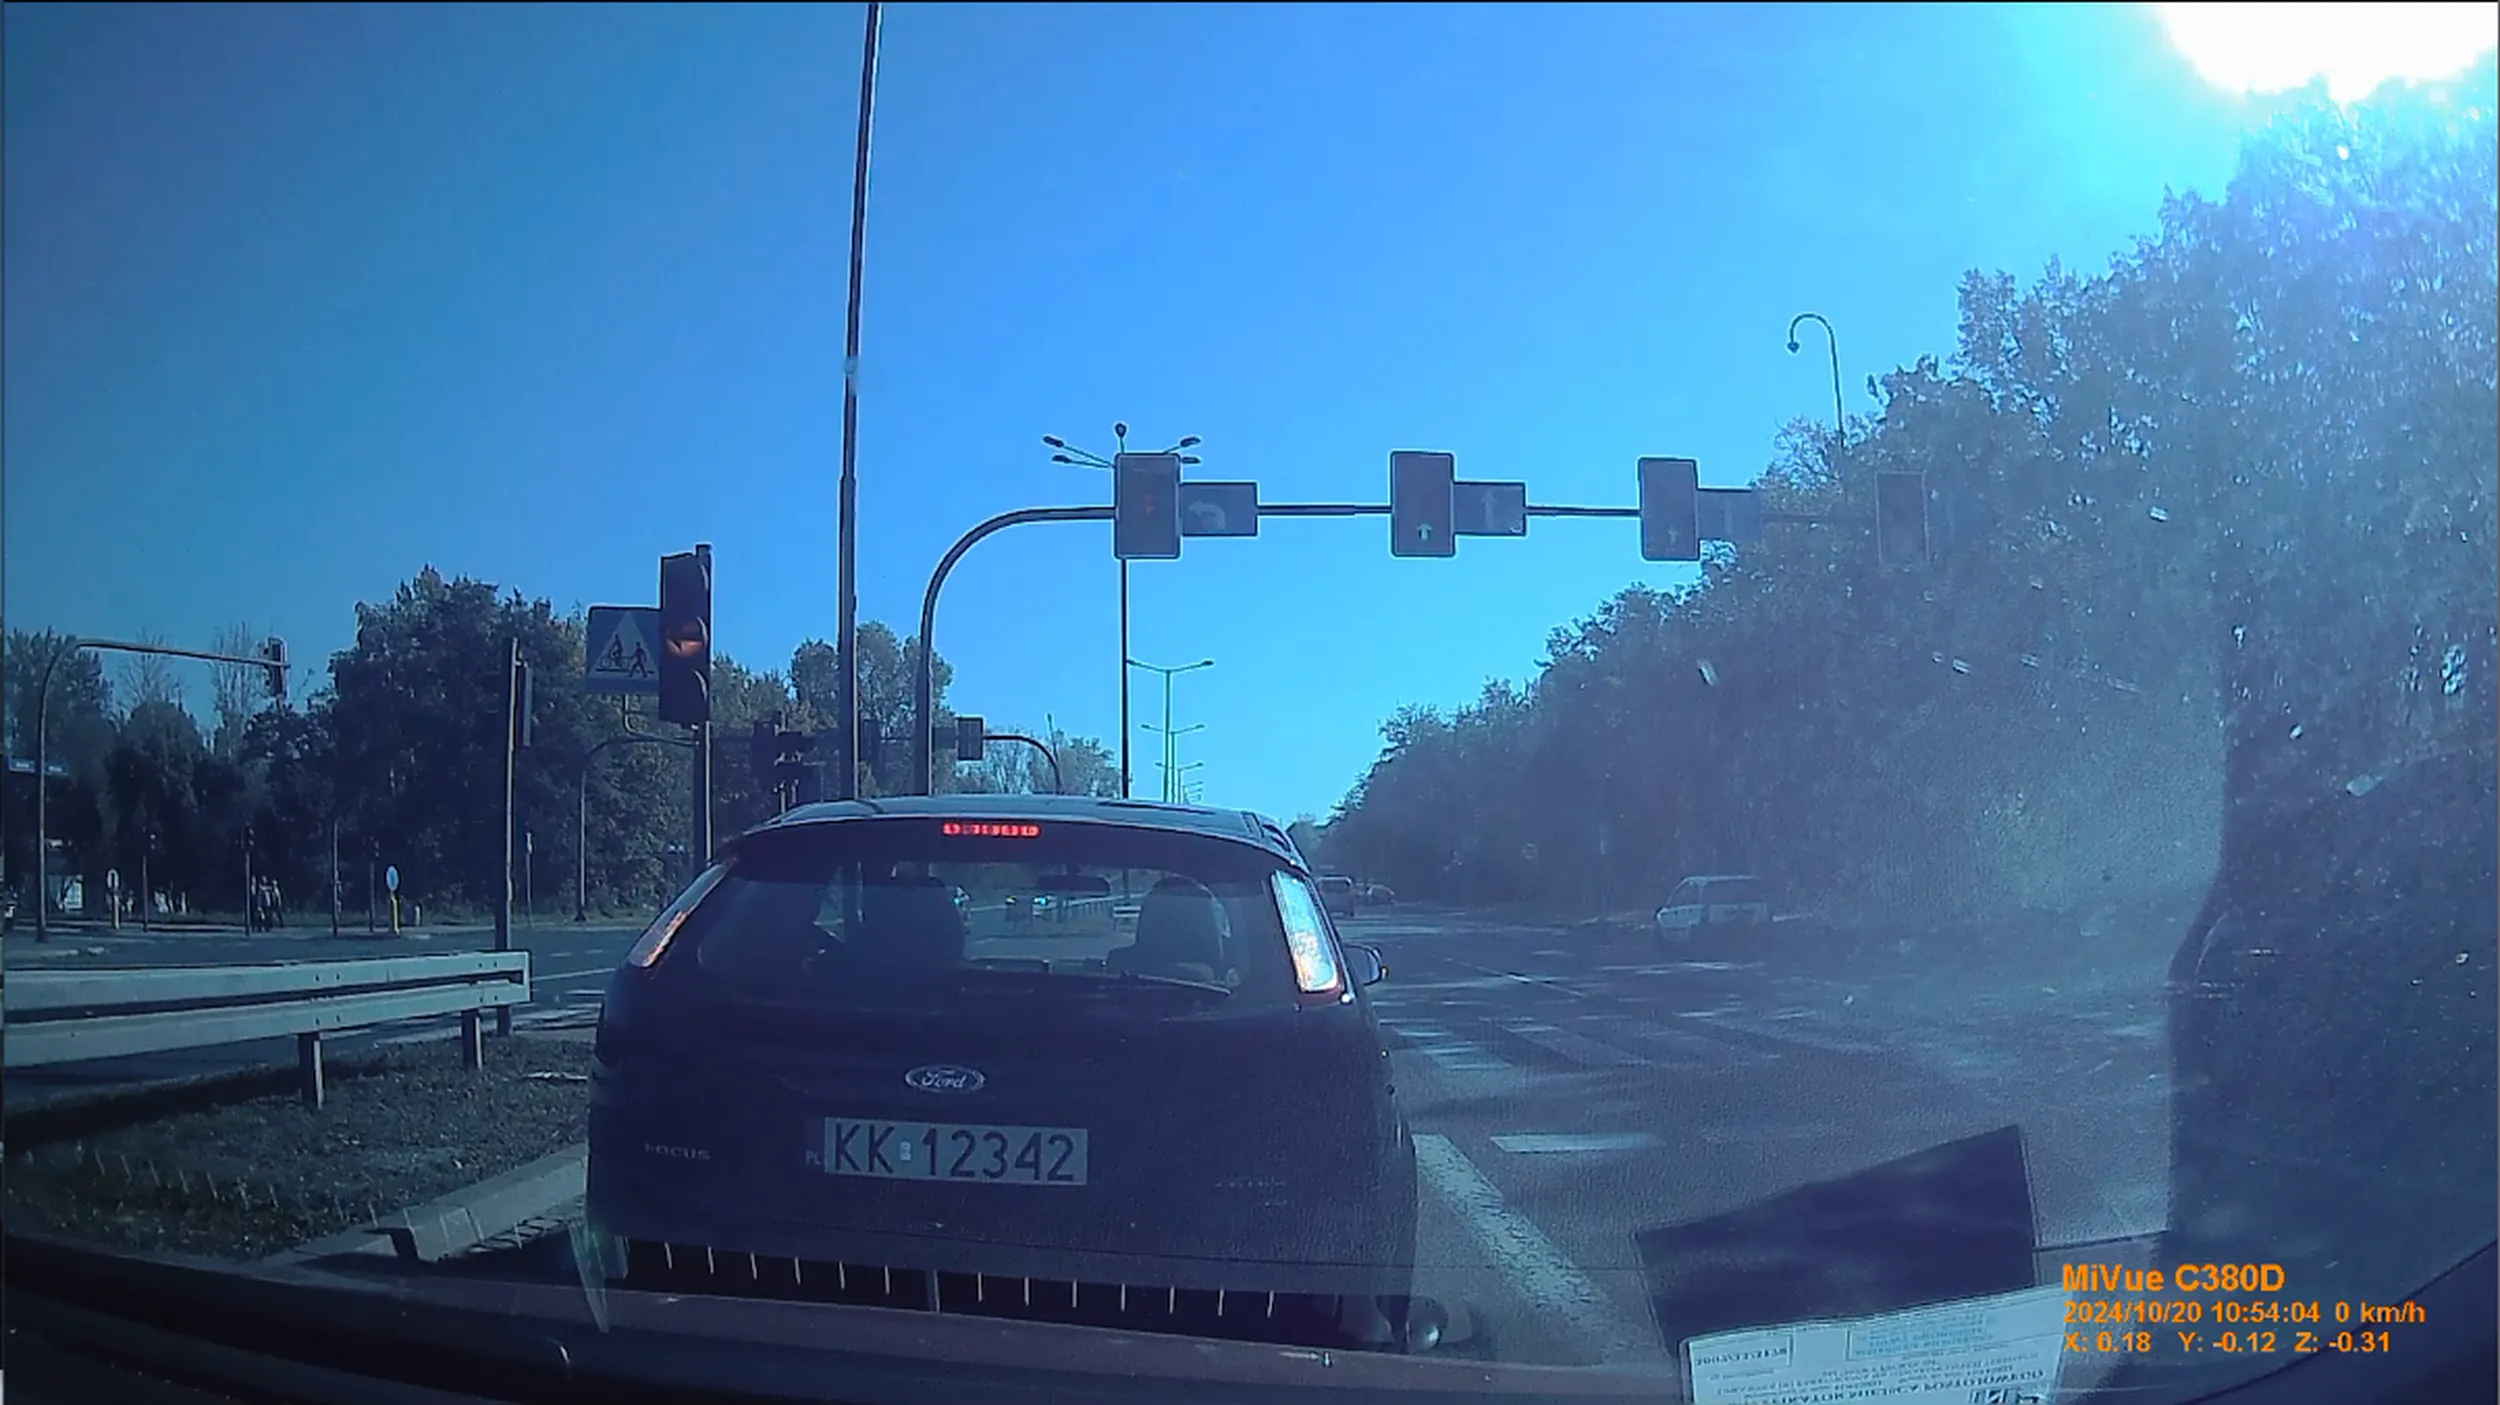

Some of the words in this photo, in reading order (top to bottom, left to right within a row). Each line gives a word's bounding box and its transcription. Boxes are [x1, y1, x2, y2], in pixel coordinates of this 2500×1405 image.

[917, 1067, 970, 1088] Ford
[643, 1141, 709, 1159] FOCUS
[804, 1150, 821, 1166] PL
[835, 1122, 895, 1175] KK
[921, 1127, 1075, 1182] 12342
